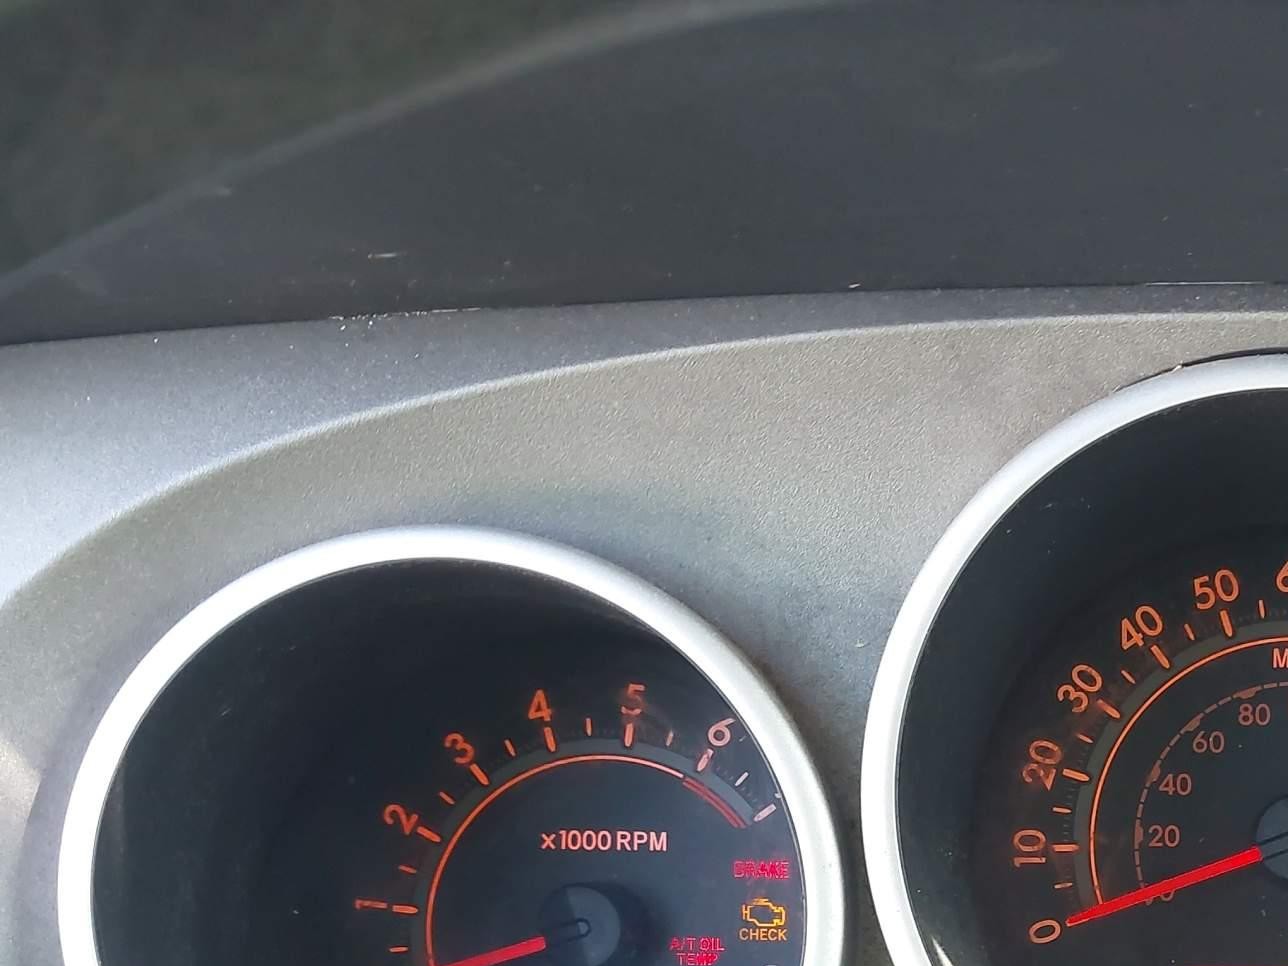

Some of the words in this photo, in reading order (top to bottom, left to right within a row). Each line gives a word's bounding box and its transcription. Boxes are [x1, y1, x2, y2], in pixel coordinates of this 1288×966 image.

[1193, 569, 1241, 610] 50
[1119, 606, 1163, 652] 40
[620, 683, 646, 716] 5
[1058, 664, 1103, 712] 30
[528, 690, 552, 721] 4
[1238, 704, 1271, 726] 80
[707, 718, 734, 747] 6
[1193, 732, 1225, 753] 60
[444, 733, 474, 765] 3
[1023, 740, 1062, 788] 20
[1159, 773, 1192, 796] 40
[384, 804, 419, 833] 2
[541, 830, 611, 850] x1000
[617, 831, 667, 851] RPM
[1014, 829, 1047, 866] 10
[1149, 825, 1180, 847] 20
[734, 861, 789, 878] BRAKE
[355, 898, 388, 910] 1
[739, 928, 787, 941] CHECK
[1029, 919, 1061, 943] 0
[700, 938, 724, 951] OIL
